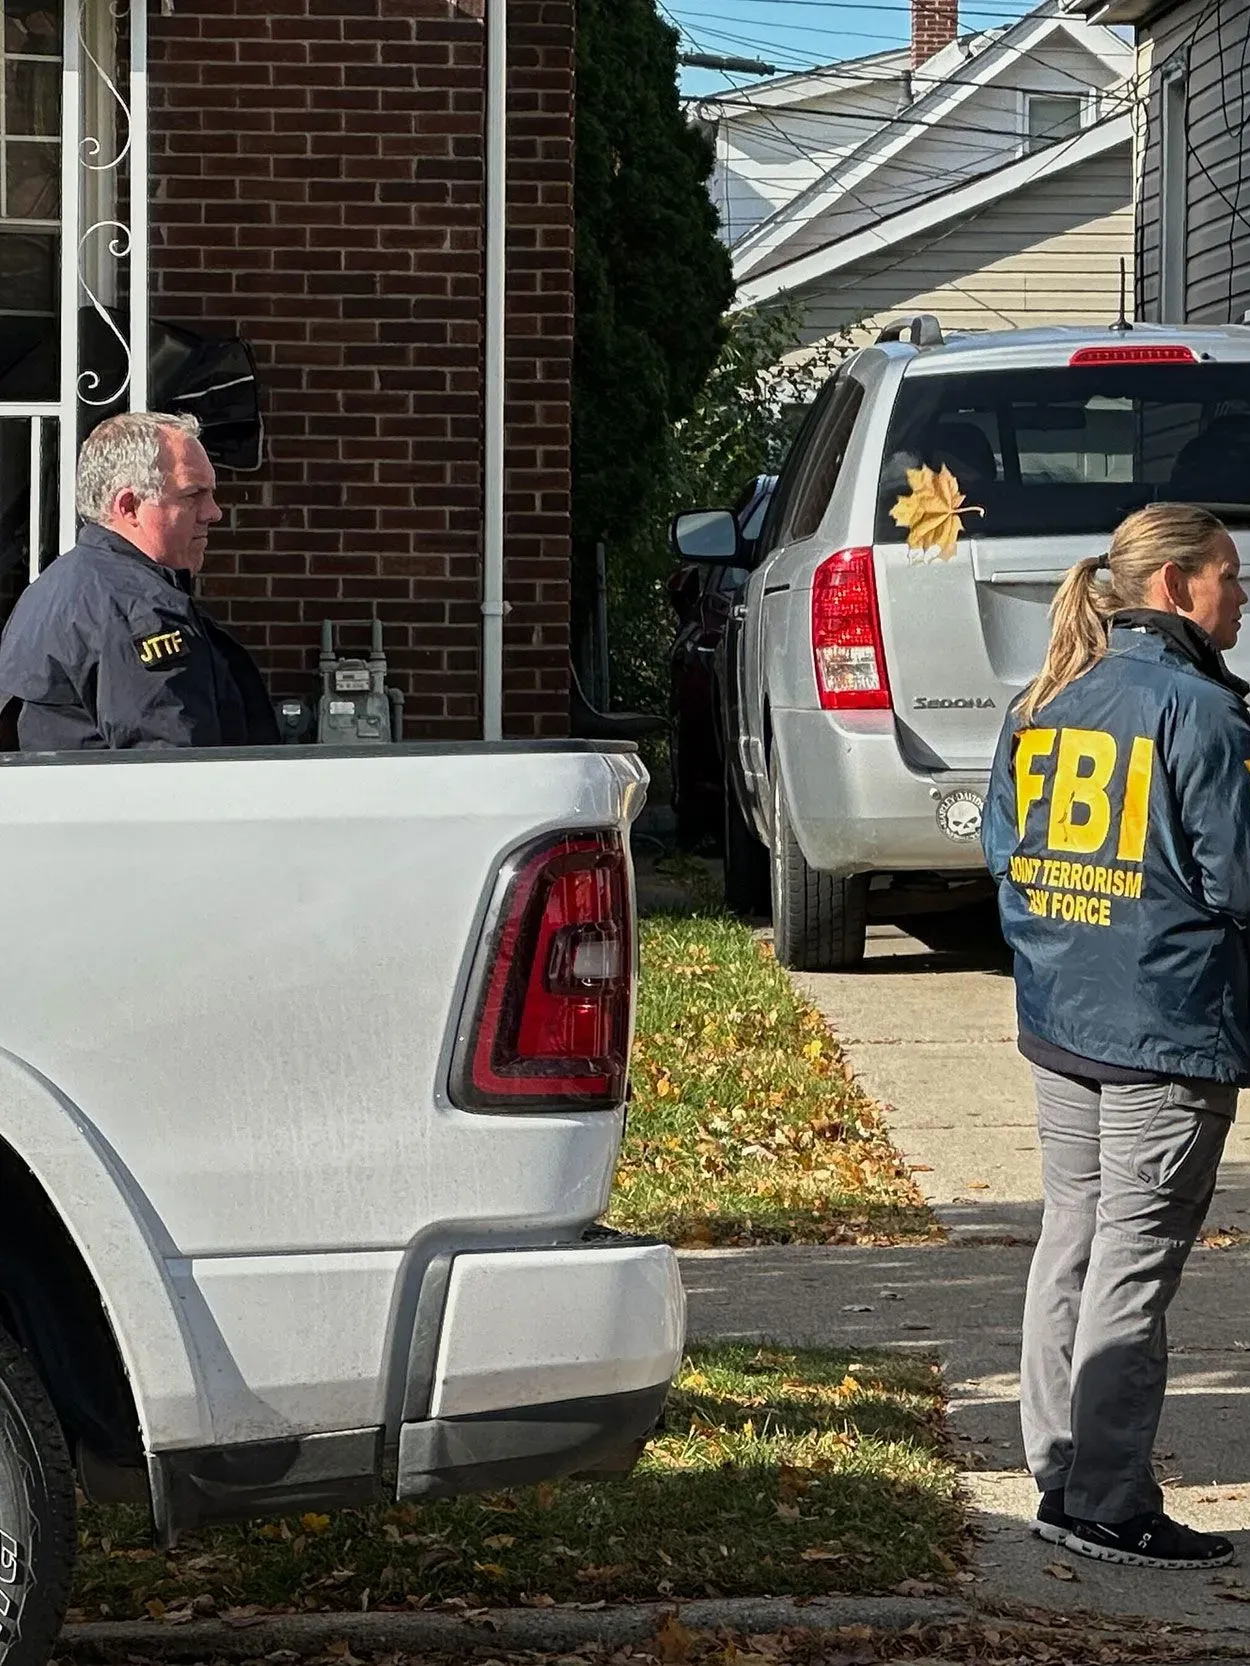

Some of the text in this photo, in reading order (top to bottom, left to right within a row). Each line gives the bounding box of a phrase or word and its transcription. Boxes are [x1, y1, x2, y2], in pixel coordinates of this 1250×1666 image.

[140, 630, 182, 663] JTTF
[913, 697, 996, 710] SEDONA
[1015, 727, 1155, 862] FBI
[1010, 855, 1143, 899] JOINT TERRORISM
[1051, 892, 1112, 926] FORCE
